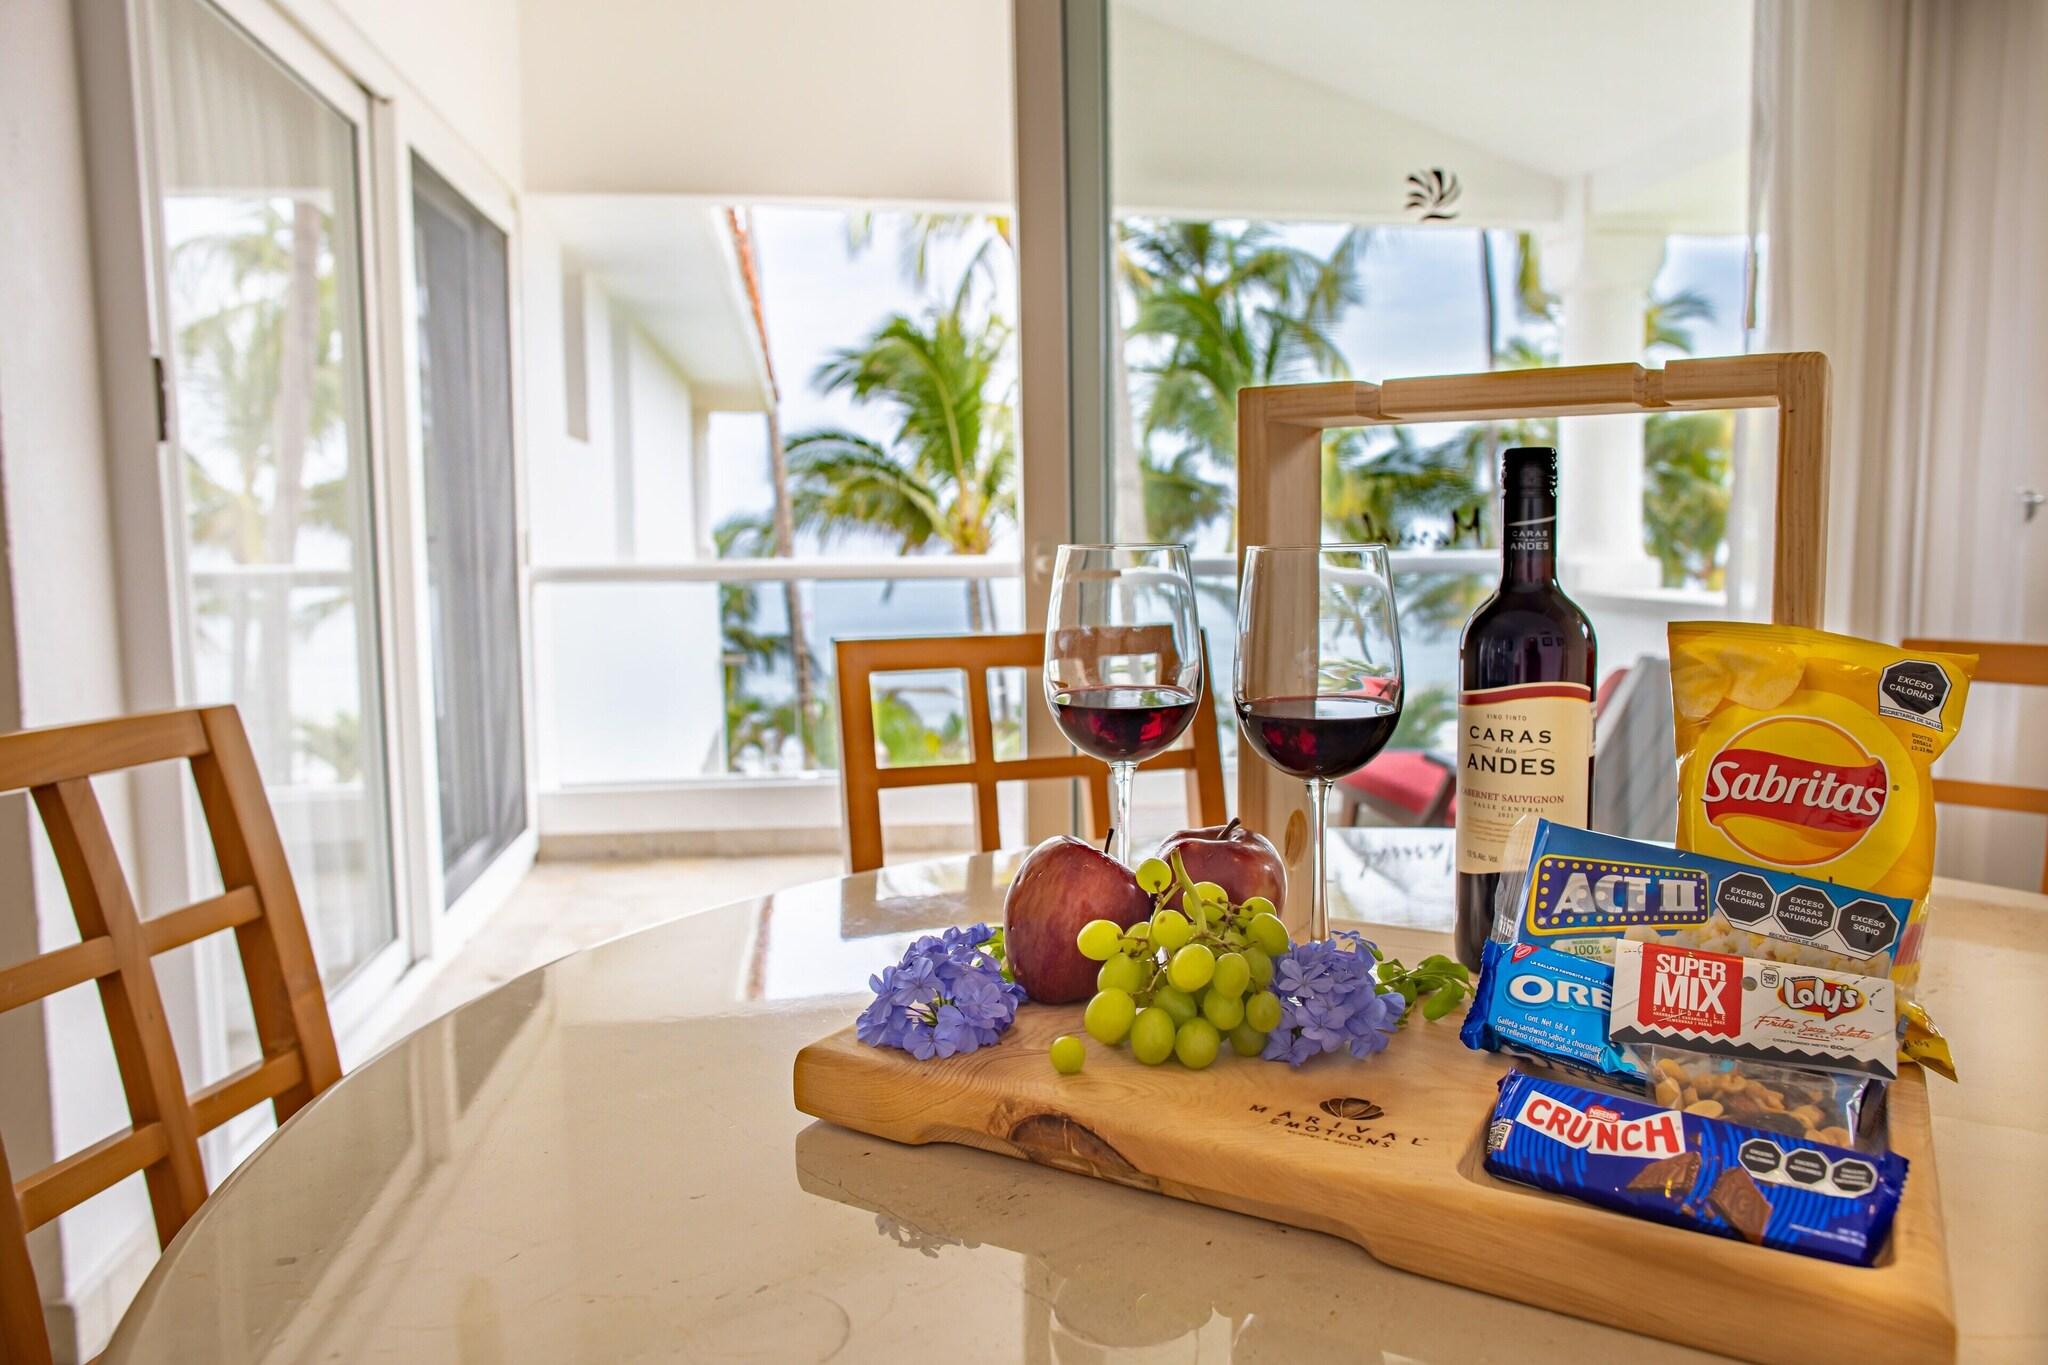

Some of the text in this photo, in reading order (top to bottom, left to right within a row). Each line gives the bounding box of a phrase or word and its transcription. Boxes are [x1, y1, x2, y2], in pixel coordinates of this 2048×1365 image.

[1512, 530, 1549, 538] CARAS
[1511, 542, 1549, 550] ANDES
[1897, 675, 1934, 691] EXCESO
[1889, 683, 1935, 702] CALORÍAS
[1469, 725, 1552, 744] CARAS
[1495, 746, 1505, 754] de
[1467, 752, 1556, 776] ANDES
[1701, 761, 1886, 816] Sabritas
[1501, 793, 1565, 805] SAUVIGNON
[1501, 804, 1545, 813] CENTRAL
[1552, 872, 1699, 914] ACT II
[1730, 886, 1764, 900] EXCESO
[1724, 894, 1766, 909] CALORÍAS
[1790, 896, 1825, 909] EXCESO
[1788, 904, 1823, 918] GRASAS
[1778, 911, 1830, 928] SATURADAS
[1850, 914, 1887, 929] EXCESO
[1853, 924, 1880, 937] SODIO
[1573, 944, 1601, 956] 100%
[1656, 953, 1727, 982] SUPER
[1509, 974, 1613, 1011] ORE
[1653, 972, 1728, 1015] MIX
[1783, 976, 1859, 1013] Loly's
[1653, 1005, 1727, 1020] SALUDABLE
[1494, 1024, 1506, 1034] con
[1506, 1027, 1528, 1041] relleno
[1529, 1034, 1555, 1048] cremoso
[1555, 1041, 1574, 1054] sabor
[1497, 1015, 1518, 1030] Galleta
[1519, 1022, 1548, 1038] sandwich
[1548, 1030, 1566, 1043] sabor
[1571, 1038, 1603, 1053] chocolate
[1571, 1028, 1577, 1036] g
[1249, 1104, 1424, 1146] MARIVAL
[1526, 1099, 1681, 1153] CRUNCH
[1269, 1118, 1391, 1149] EMOTIONS
